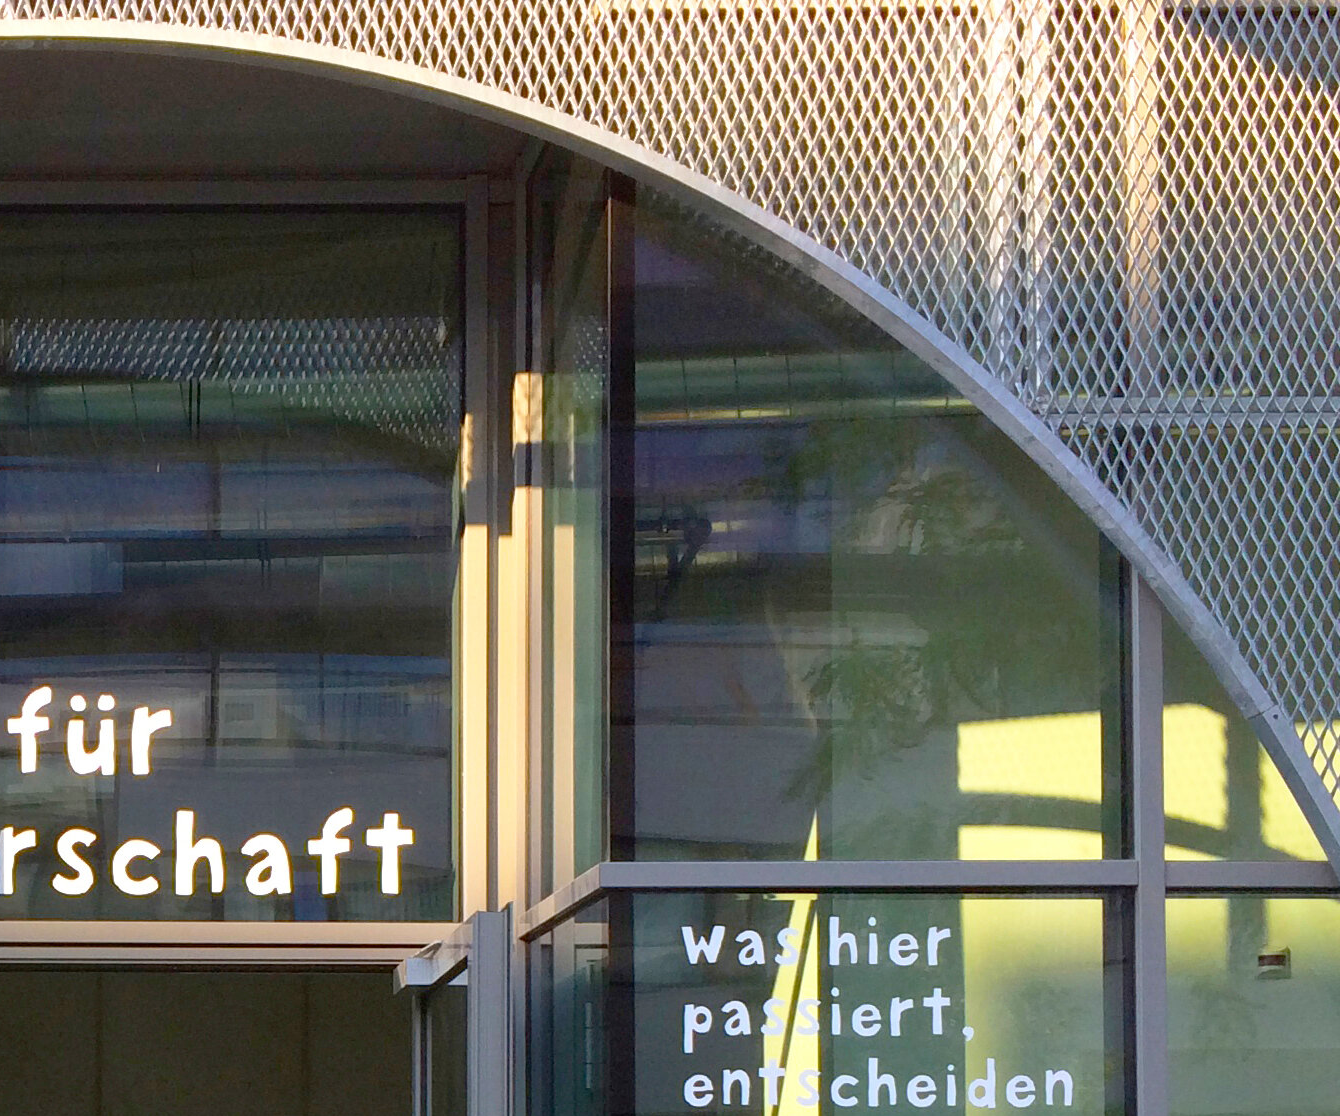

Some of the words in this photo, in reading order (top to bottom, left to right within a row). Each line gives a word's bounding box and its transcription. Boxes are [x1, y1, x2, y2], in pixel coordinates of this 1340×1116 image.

[7, 686, 173, 776] für
[681, 925, 800, 967] was
[828, 916, 952, 967] hier
[683, 987, 976, 1054] passiert,
[684, 1057, 1074, 1109] entscheiden
